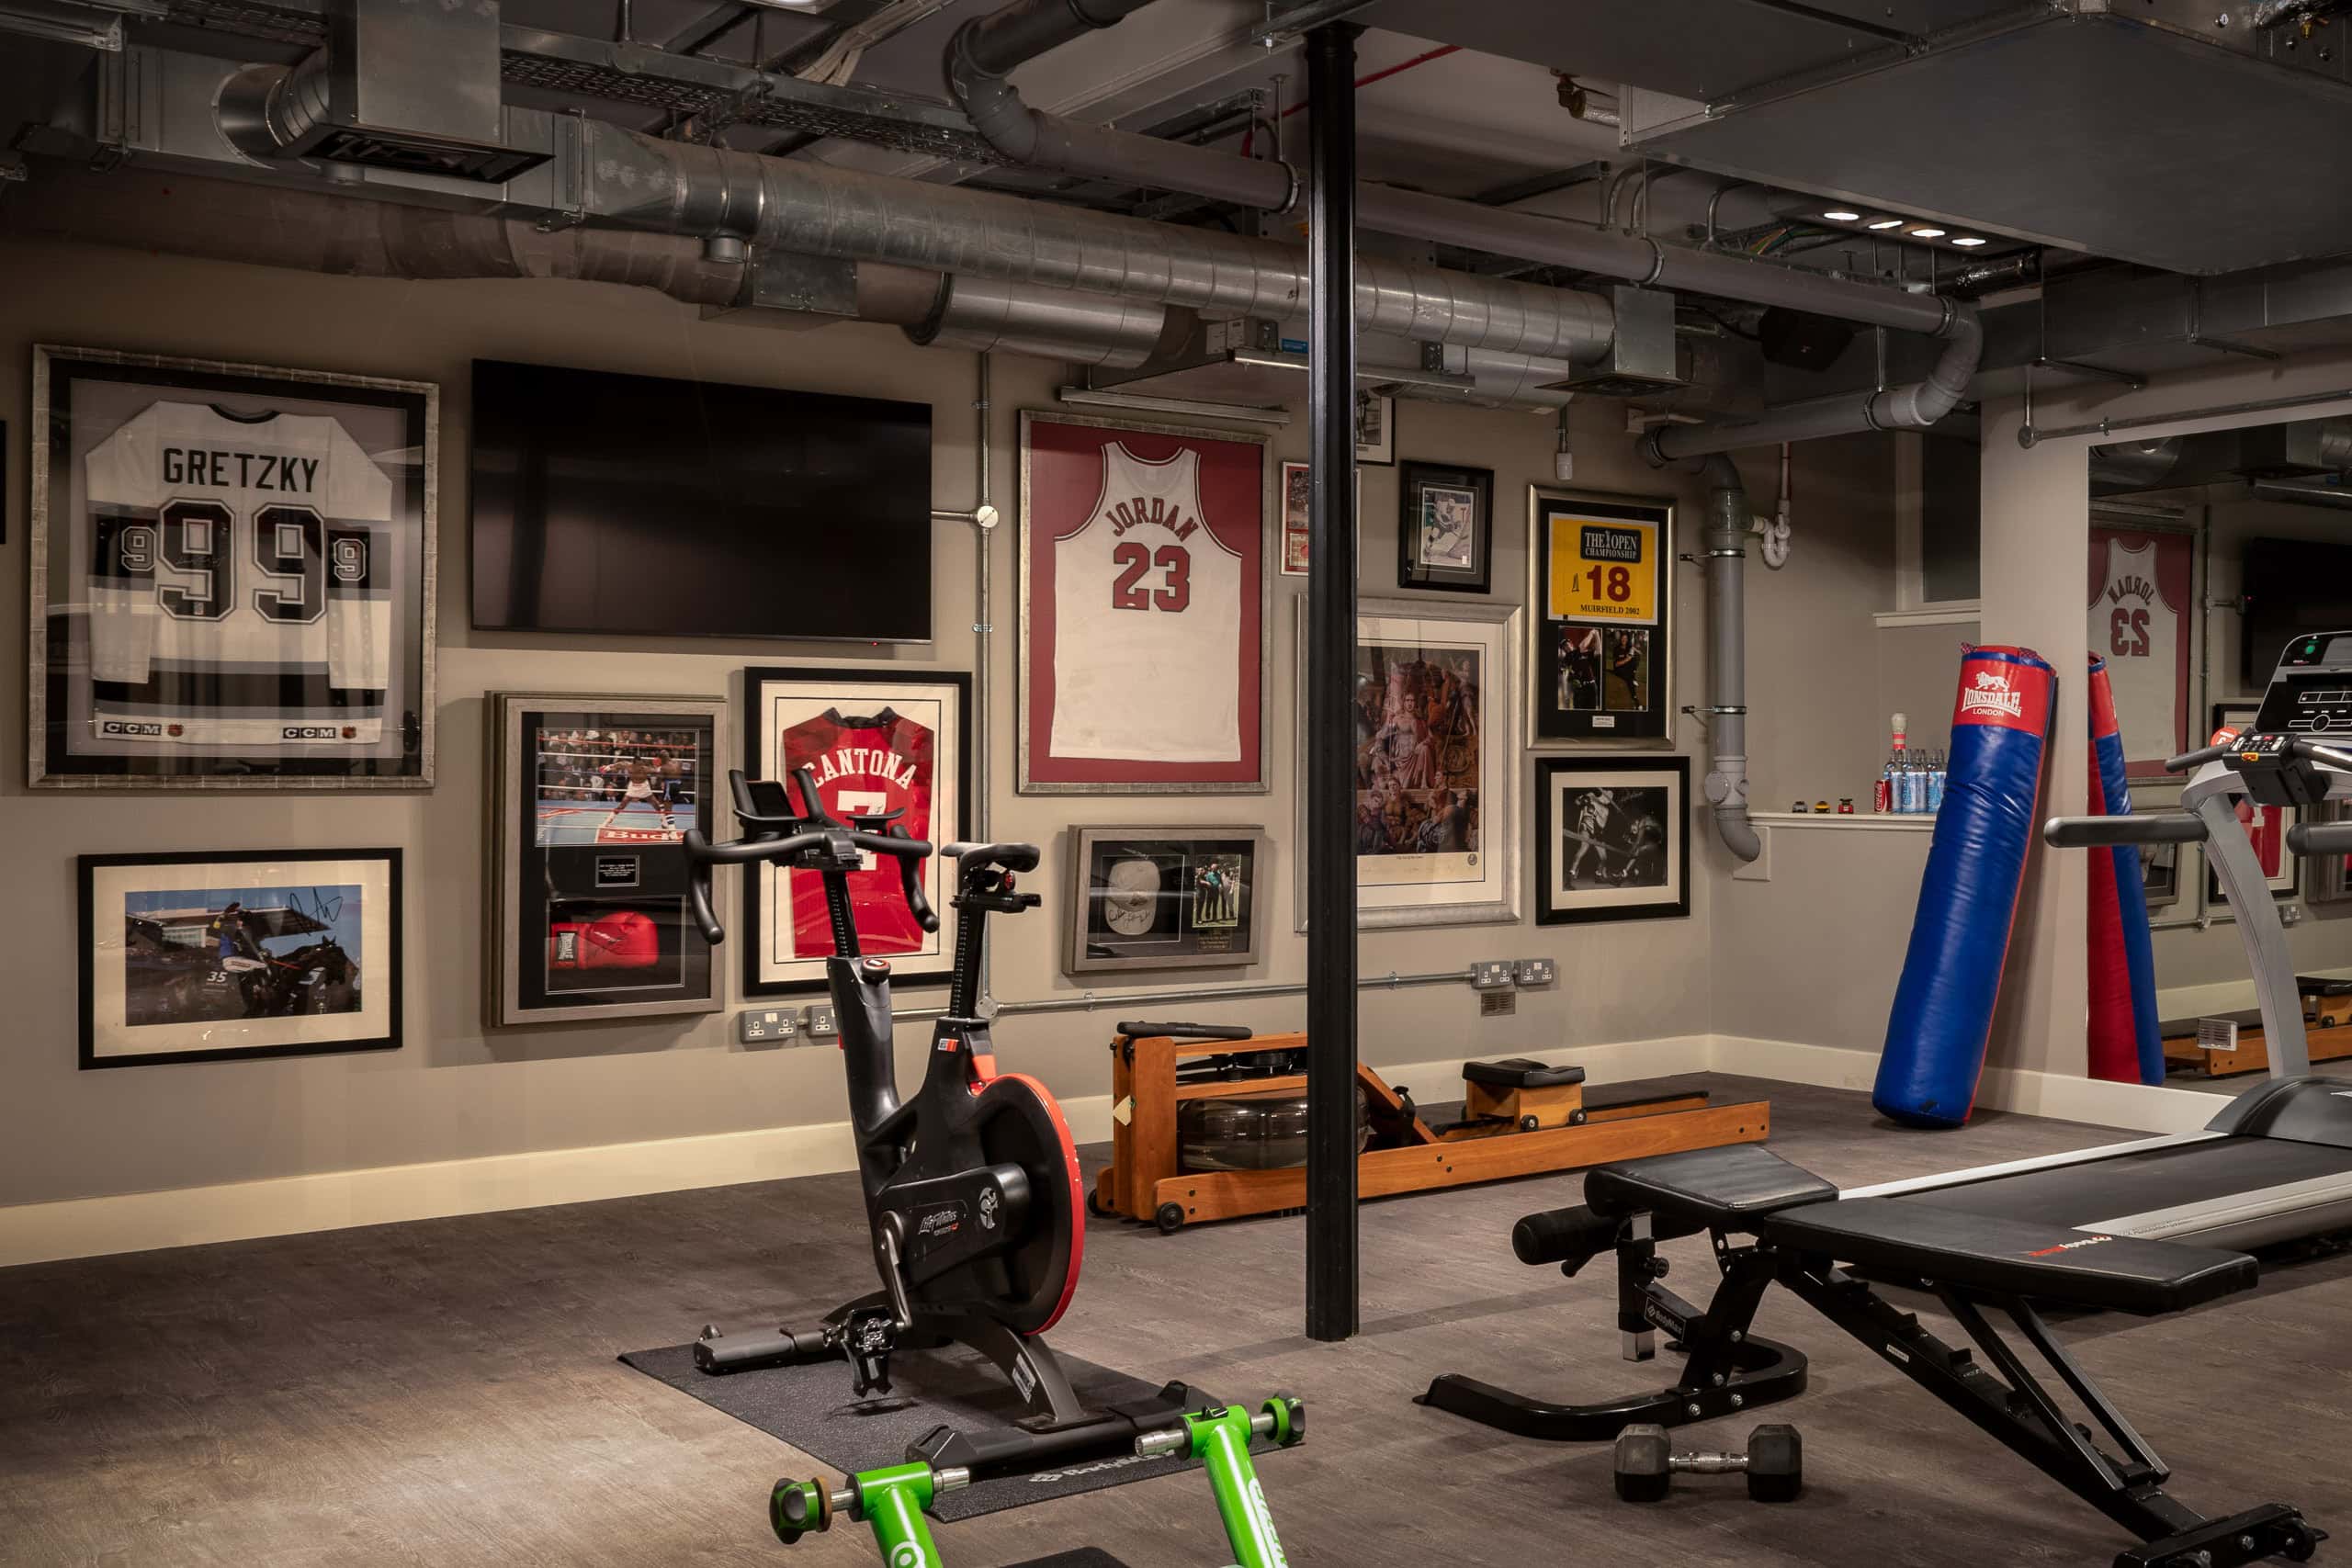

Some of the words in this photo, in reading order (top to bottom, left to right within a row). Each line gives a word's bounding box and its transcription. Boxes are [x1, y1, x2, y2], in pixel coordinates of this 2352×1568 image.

[163, 447, 319, 492] GRETZKY
[1105, 496, 1199, 542] JORDAN
[1585, 532, 1605, 548] THE
[1611, 534, 1637, 550] OPEN
[156, 497, 328, 626] 99
[1585, 547, 1637, 559] CHAMPIONSHIP
[1113, 541, 1192, 614] 23
[1587, 564, 1631, 603] 18
[1580, 604, 1623, 614] MUIRFIELD
[1625, 606, 1640, 615] 2002
[1962, 687, 2022, 716] LONSDALE
[1973, 707, 2005, 716] LONDON
[104, 722, 162, 735] CCM
[283, 728, 336, 739] CCM
[207, 971, 228, 983] 35
